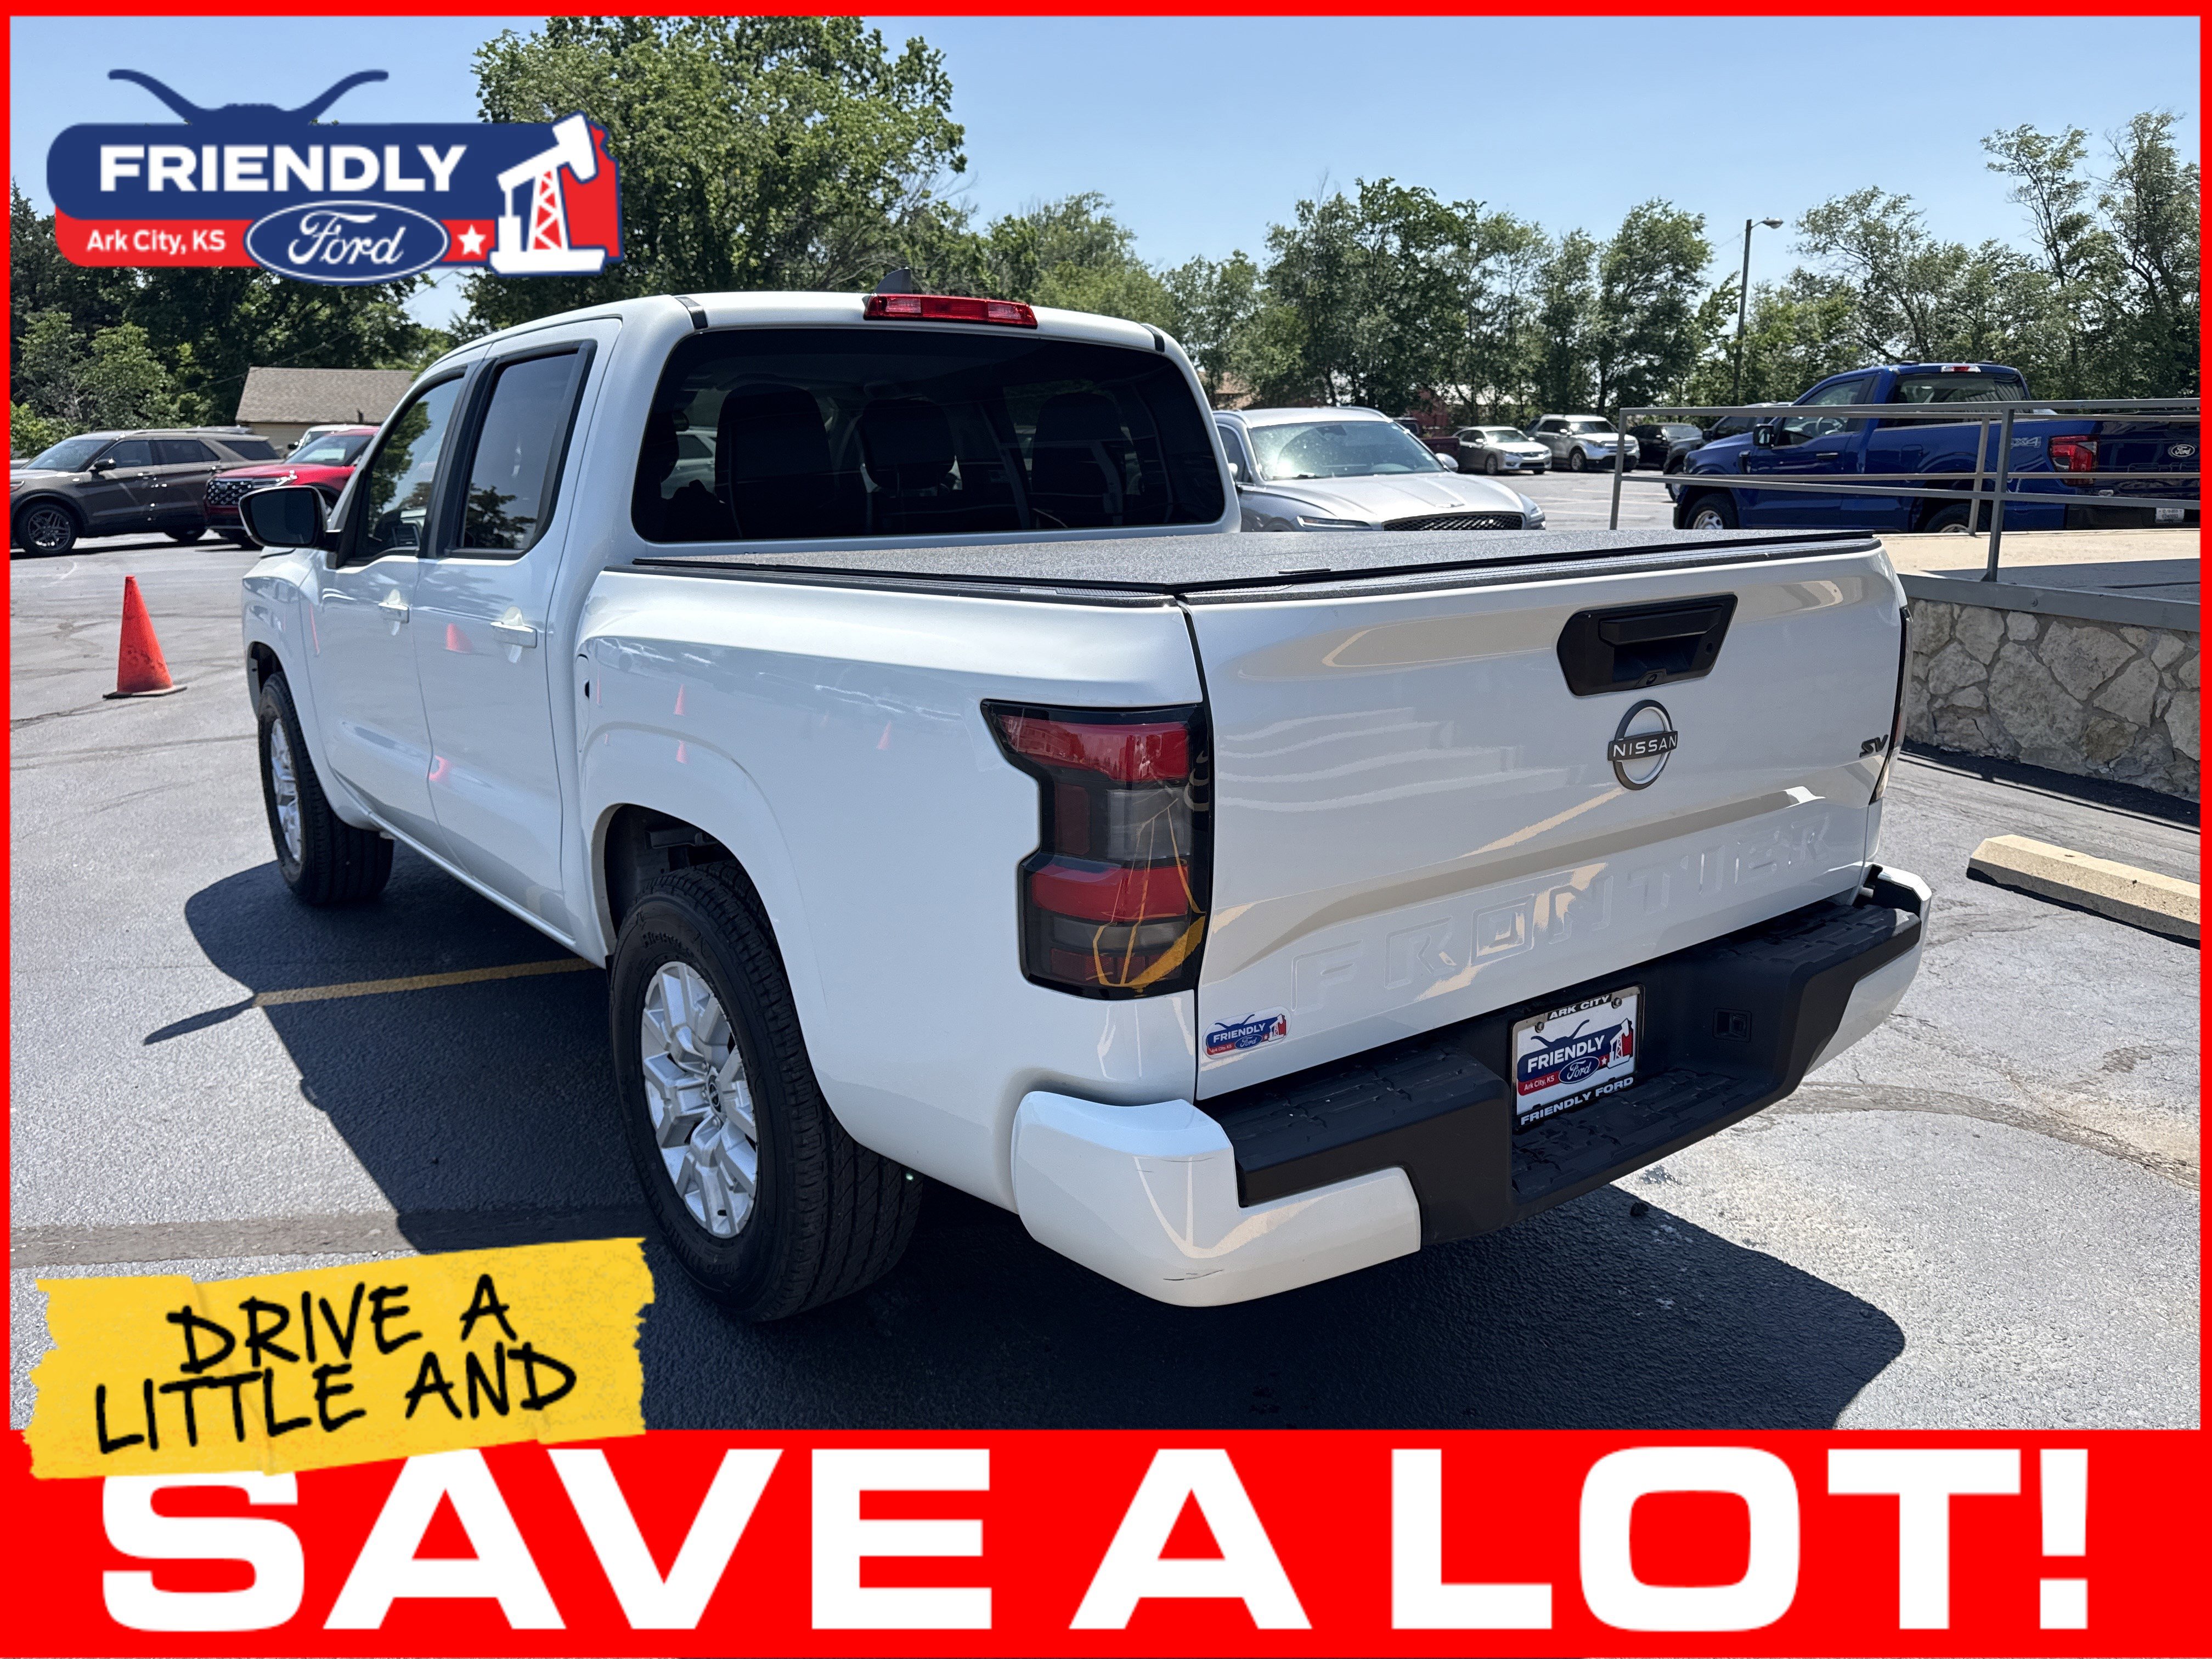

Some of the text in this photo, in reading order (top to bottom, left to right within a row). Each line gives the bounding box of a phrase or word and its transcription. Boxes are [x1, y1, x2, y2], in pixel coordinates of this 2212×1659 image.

[1613, 735, 1677, 757] NISSAN
[1859, 735, 1888, 757] SV
[1290, 812, 1832, 1015] FRONTIER
[1549, 995, 1610, 1019] ARK CITY
[1213, 1023, 1266, 1043] FRIENDLY
[1240, 1037, 1257, 1047] Ford
[1527, 1035, 1605, 1073] FRIENDLY
[1567, 1060, 1592, 1080] Ford
[1523, 1081, 1533, 1091] Ark
[1534, 1078, 1546, 1089] City,
[1521, 1077, 1634, 1125] FRIENDLY FORD
